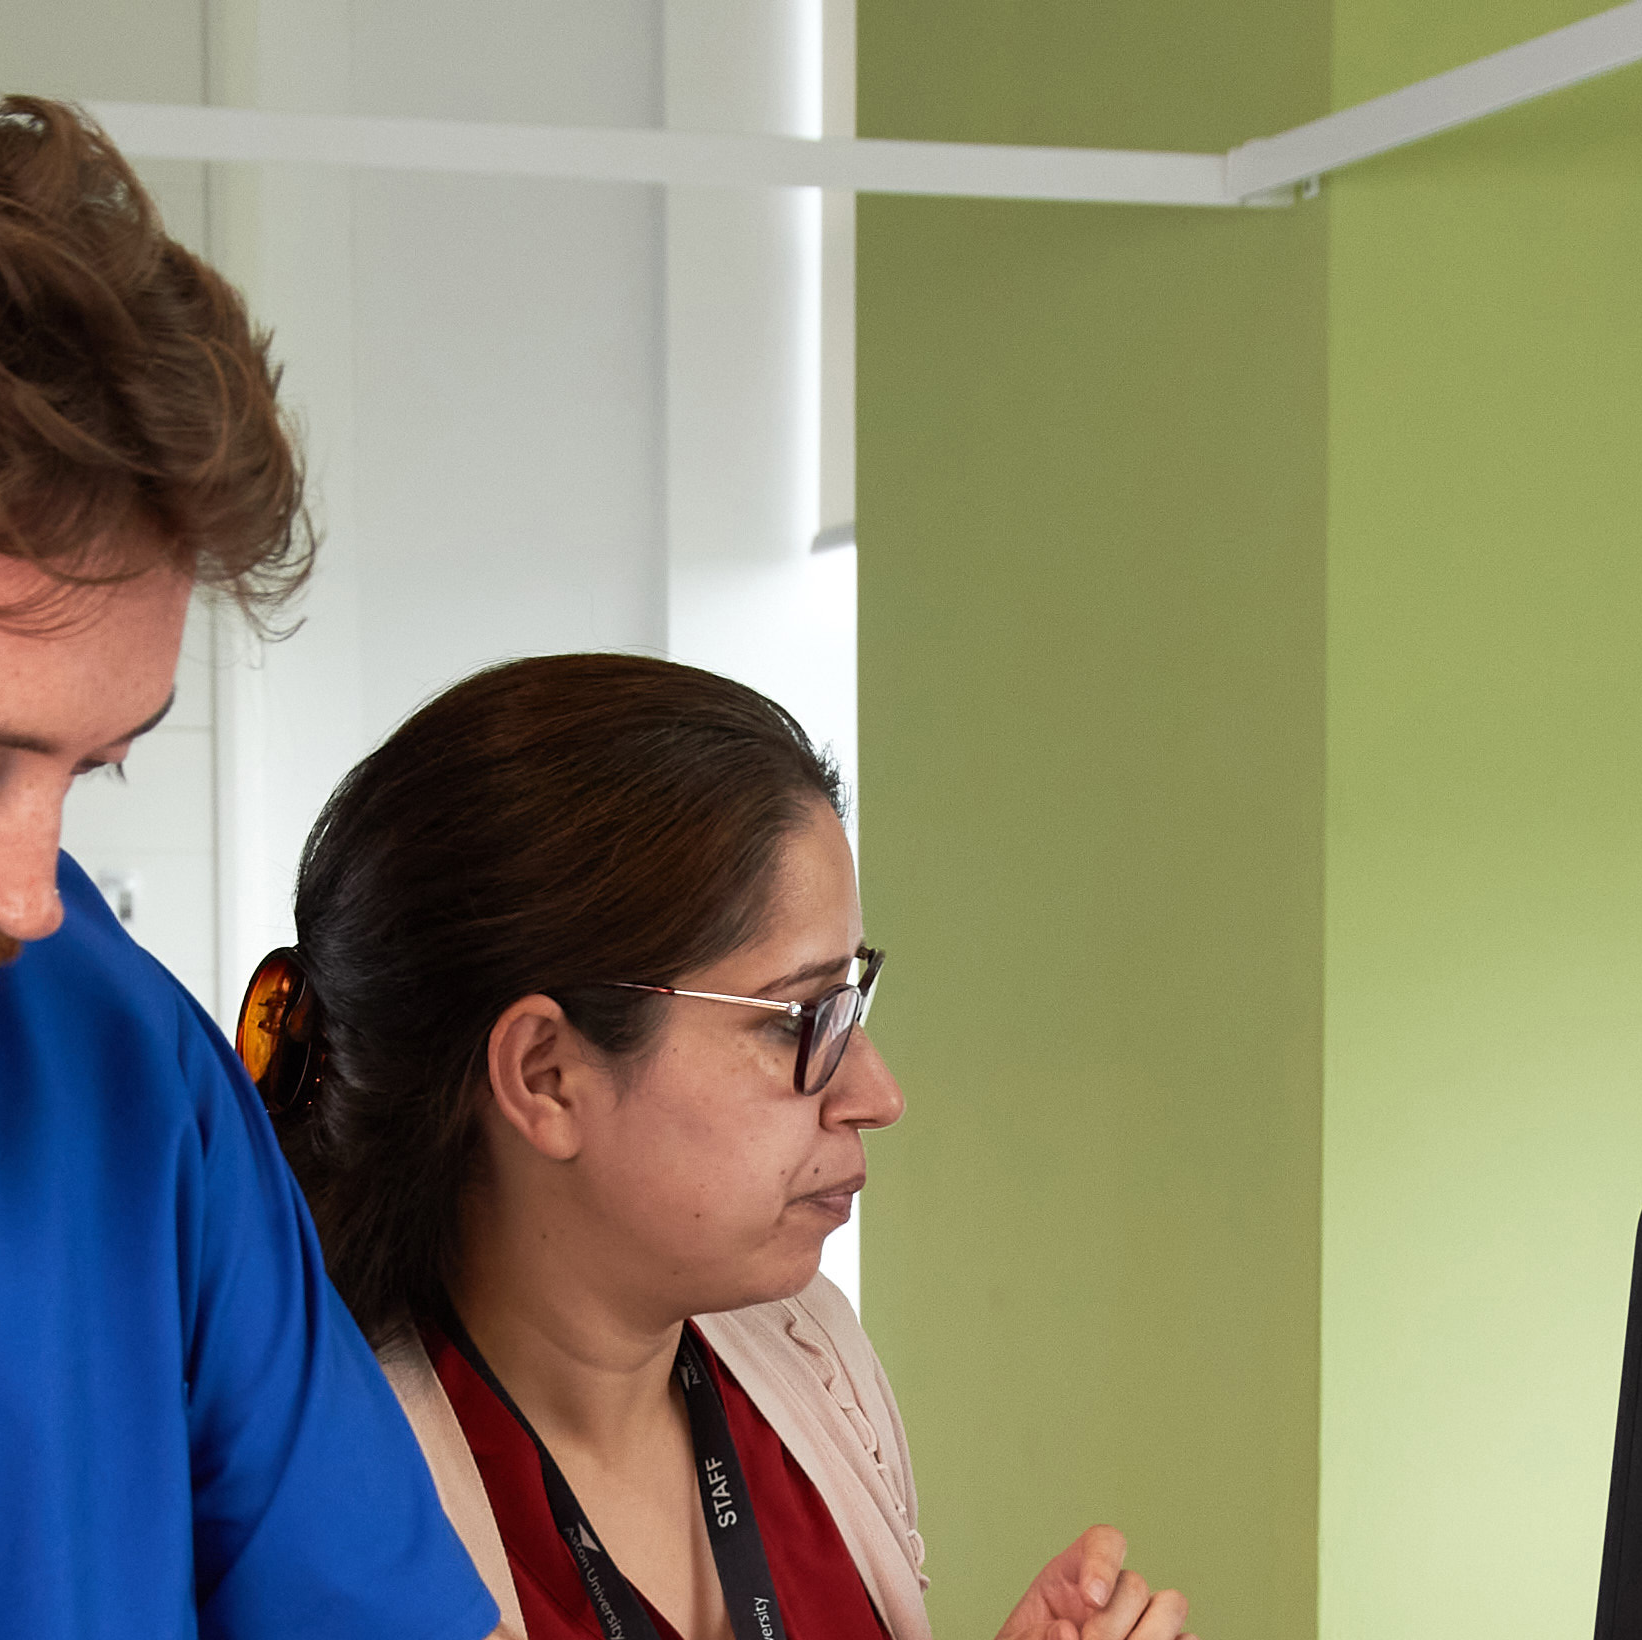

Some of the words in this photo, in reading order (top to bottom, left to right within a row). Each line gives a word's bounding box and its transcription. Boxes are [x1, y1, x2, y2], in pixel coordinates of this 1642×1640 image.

[705, 1457, 737, 1528] STAFF
[563, 1527, 590, 1569] Aston
[587, 1567, 625, 1640] University
